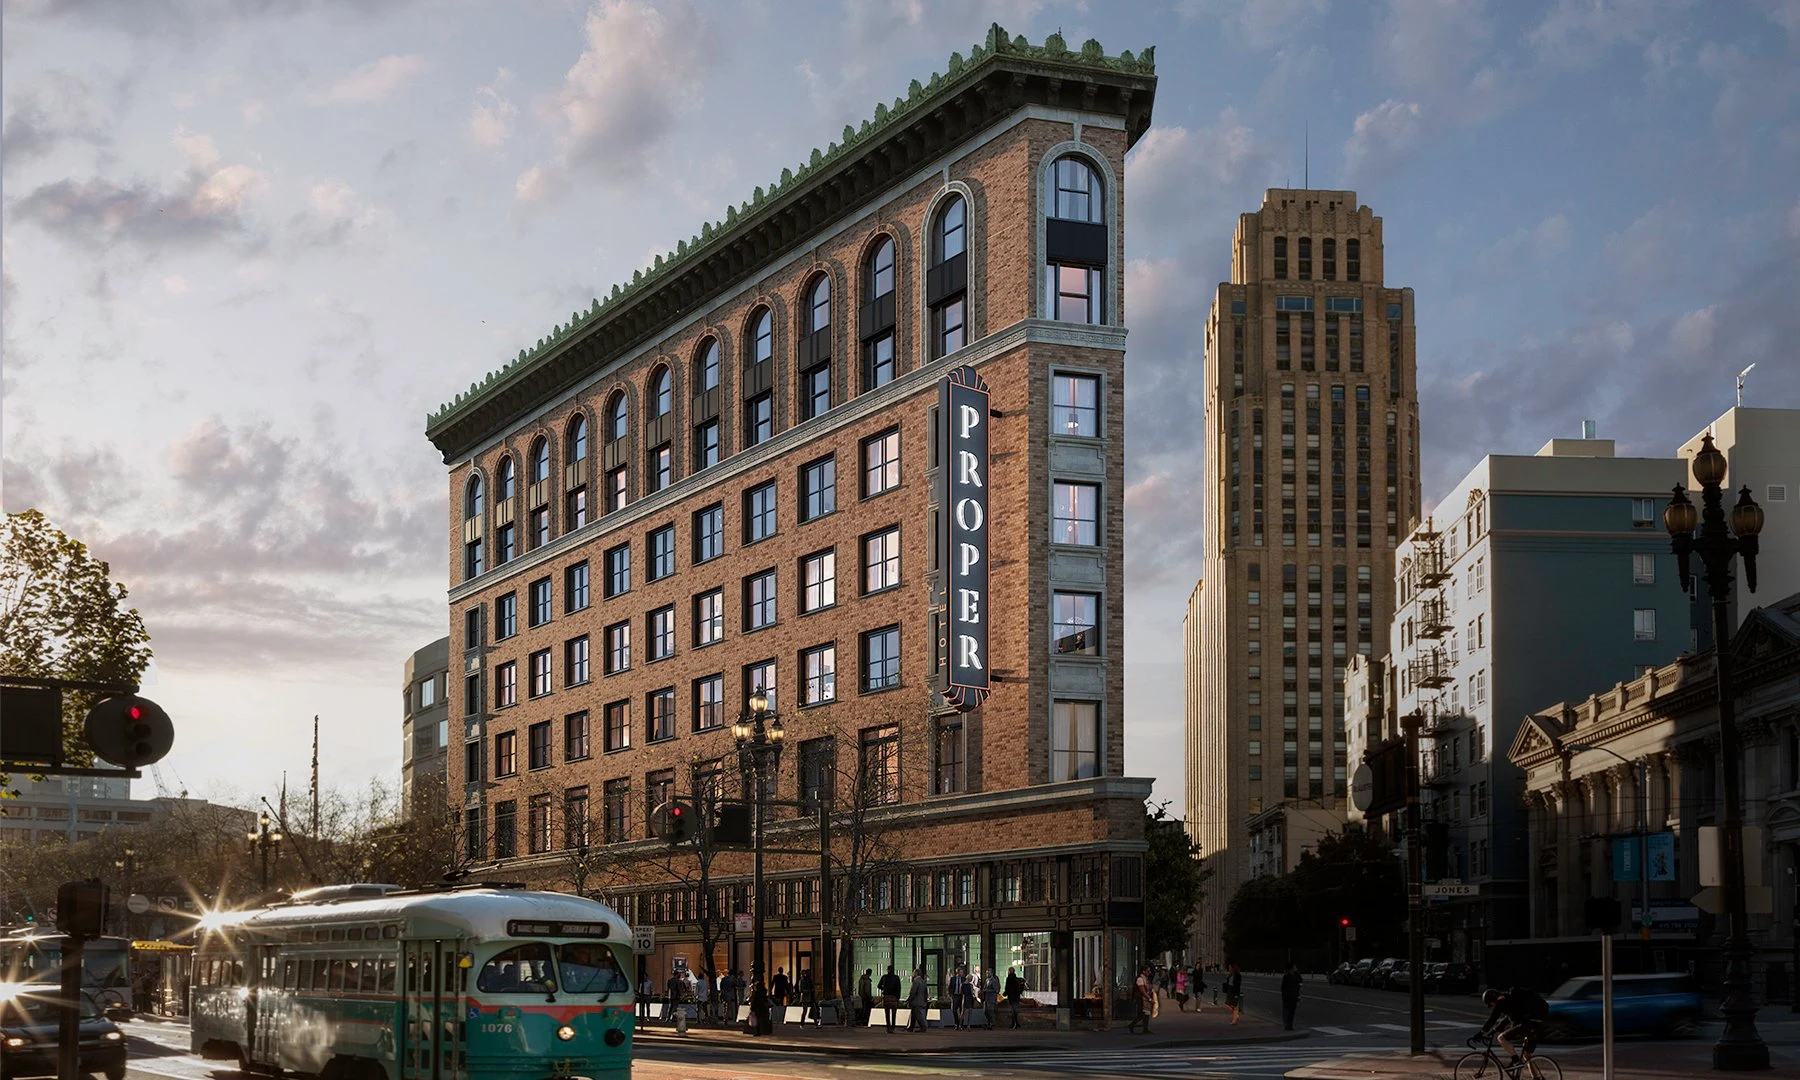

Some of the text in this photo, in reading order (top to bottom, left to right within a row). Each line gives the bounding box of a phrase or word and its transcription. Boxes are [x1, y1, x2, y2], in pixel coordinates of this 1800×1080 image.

[956, 404, 984, 670] PROPER
[939, 587, 947, 667] HOTEL
[1435, 886, 1470, 894] JONES
[637, 939, 651, 949] 10
[481, 1023, 512, 1034] 1076
